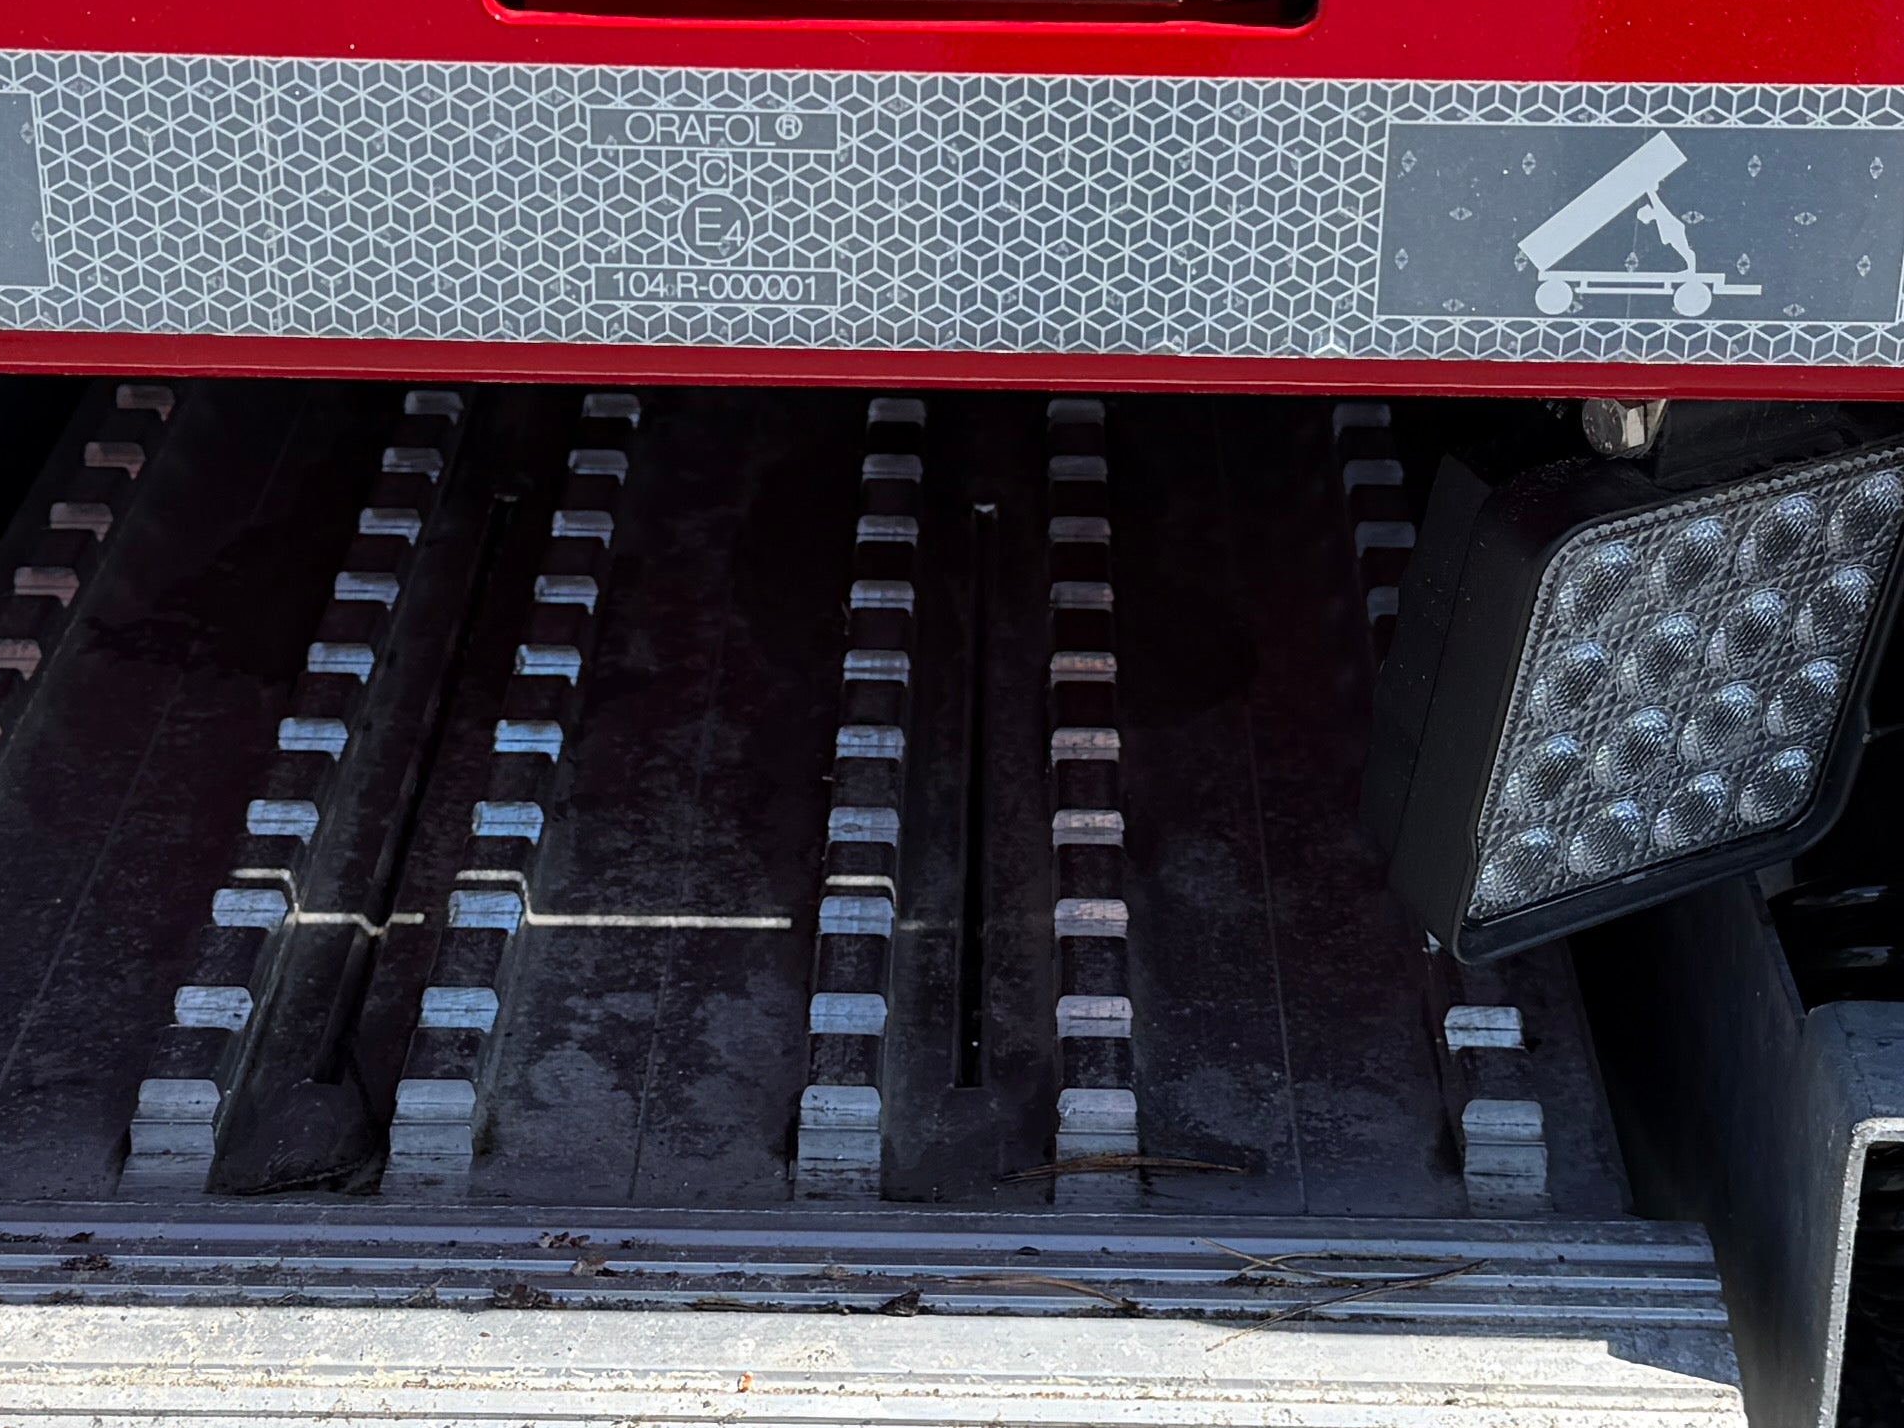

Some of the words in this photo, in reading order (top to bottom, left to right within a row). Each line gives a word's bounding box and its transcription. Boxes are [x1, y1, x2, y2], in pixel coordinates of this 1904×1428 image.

[702, 158, 727, 186] C
[613, 271, 667, 298] 104
[677, 271, 817, 301] R-000001
